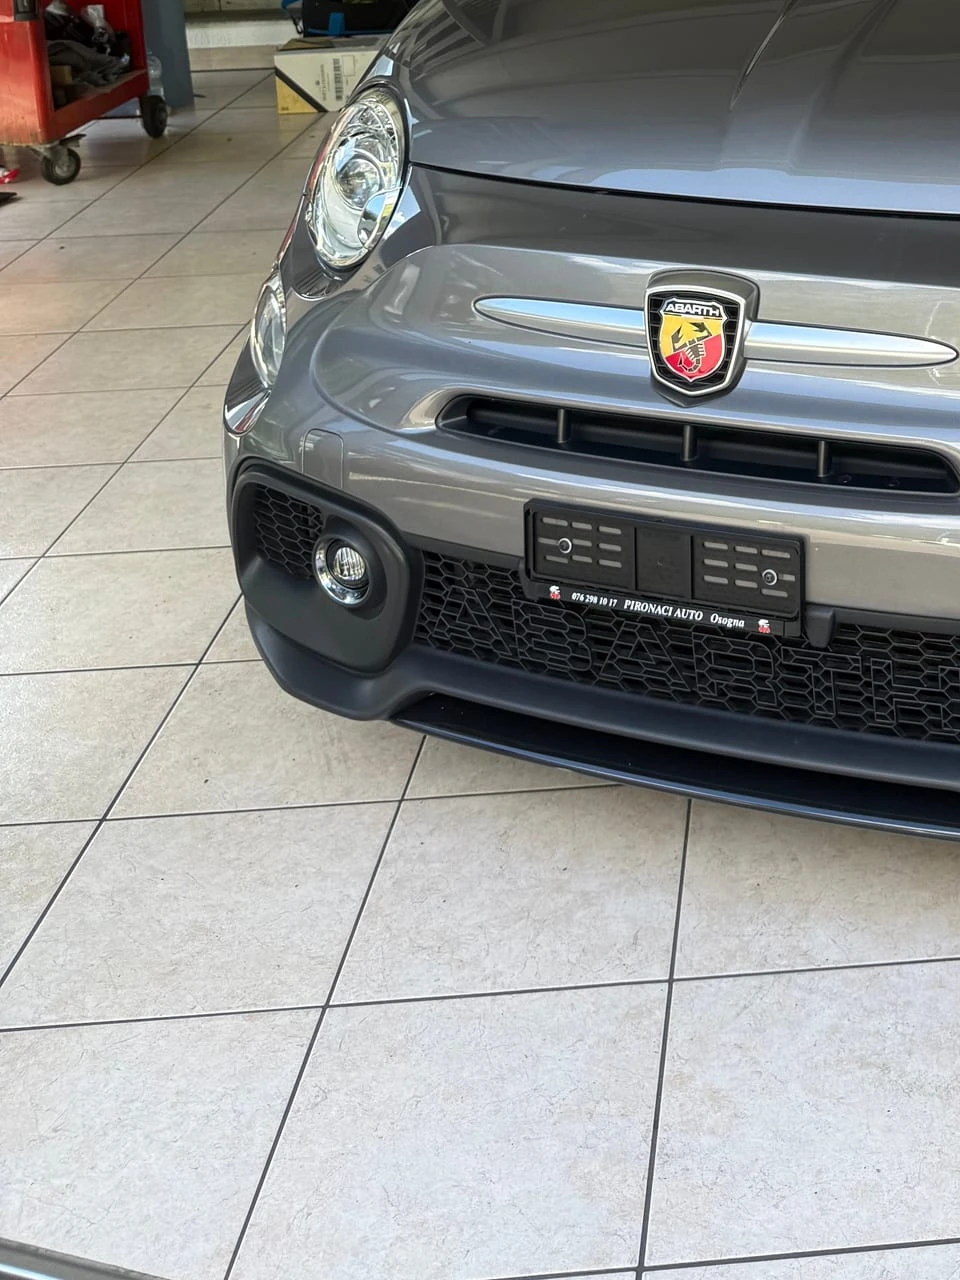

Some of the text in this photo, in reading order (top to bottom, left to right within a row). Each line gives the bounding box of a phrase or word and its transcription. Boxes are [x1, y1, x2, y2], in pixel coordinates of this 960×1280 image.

[665, 303, 720, 317] ABARTH
[571, 592, 745, 628] 076 298 10 17 PIRONACI AUTO Osogna
